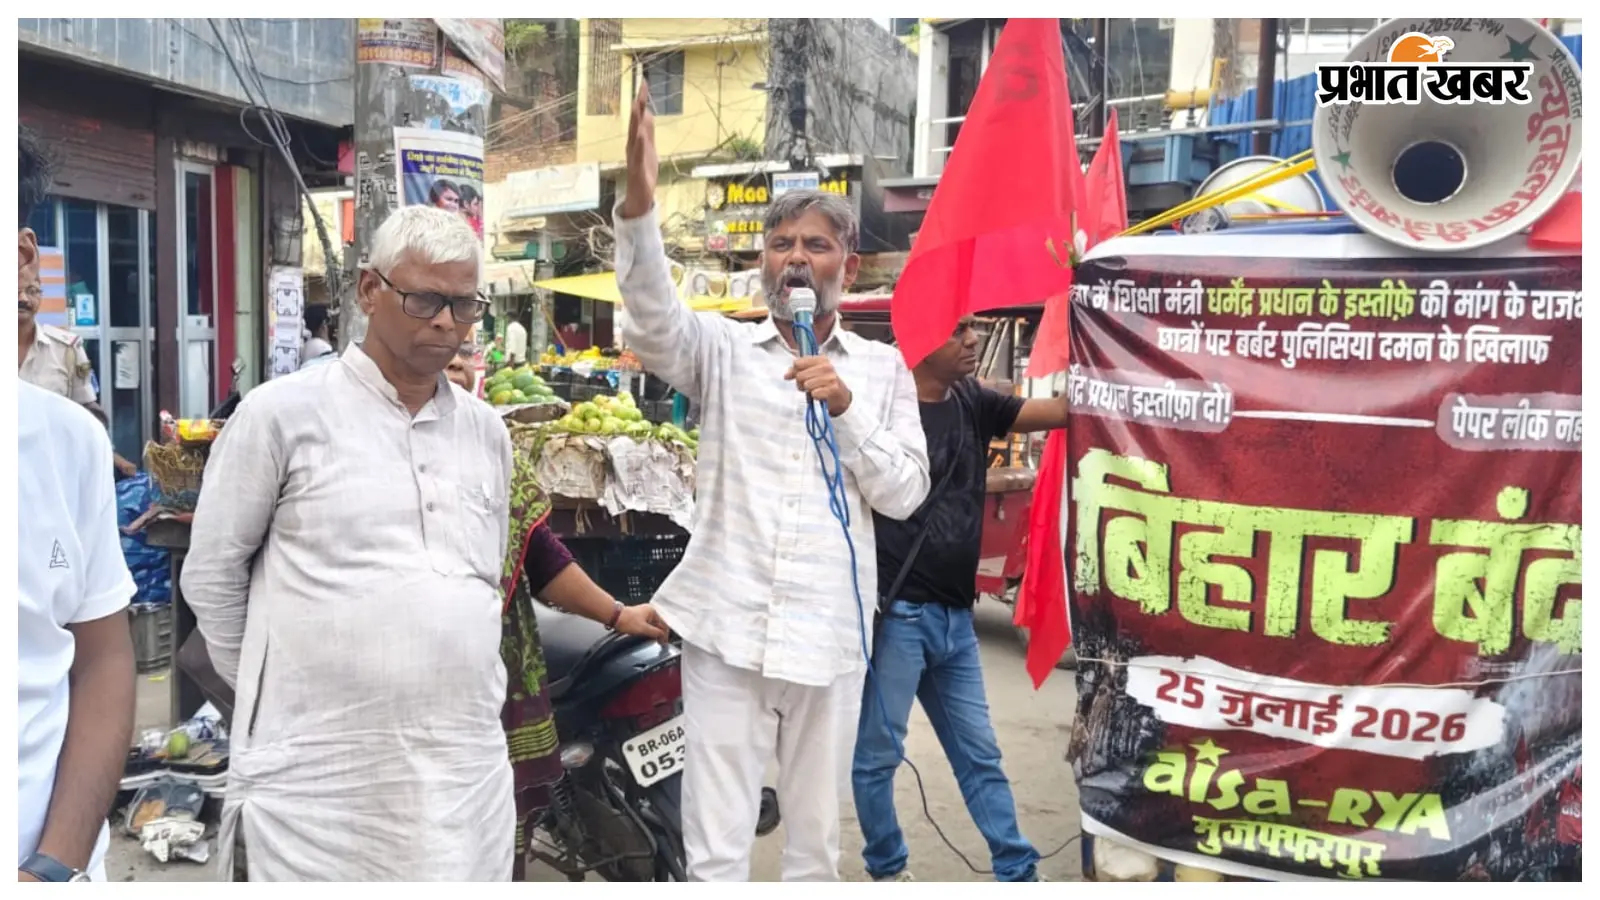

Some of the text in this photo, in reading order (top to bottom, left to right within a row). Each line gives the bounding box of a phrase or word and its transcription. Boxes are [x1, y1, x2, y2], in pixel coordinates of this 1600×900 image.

[1092, 278, 1110, 311] में
[1112, 279, 1162, 314] शिक्षा
[1164, 279, 1204, 314] मंत्री
[1258, 287, 1315, 316] प्रधान
[1318, 279, 1341, 316] के
[1420, 280, 1450, 318] की
[1453, 281, 1501, 319] मांग
[1503, 281, 1527, 319] के
[1157, 320, 1552, 368] छात्रों पर बर्बर पुलिसिया दमन के खिलाफ
[1203, 382, 1232, 423] दो!
[1452, 396, 1498, 438] पेपर
[1502, 398, 1551, 440] लीक
[1072, 448, 1413, 647] बिहार
[1156, 669, 1468, 743] 25 जुलाई 2026
[1192, 815, 1387, 879] मुजफ्फरपुर
